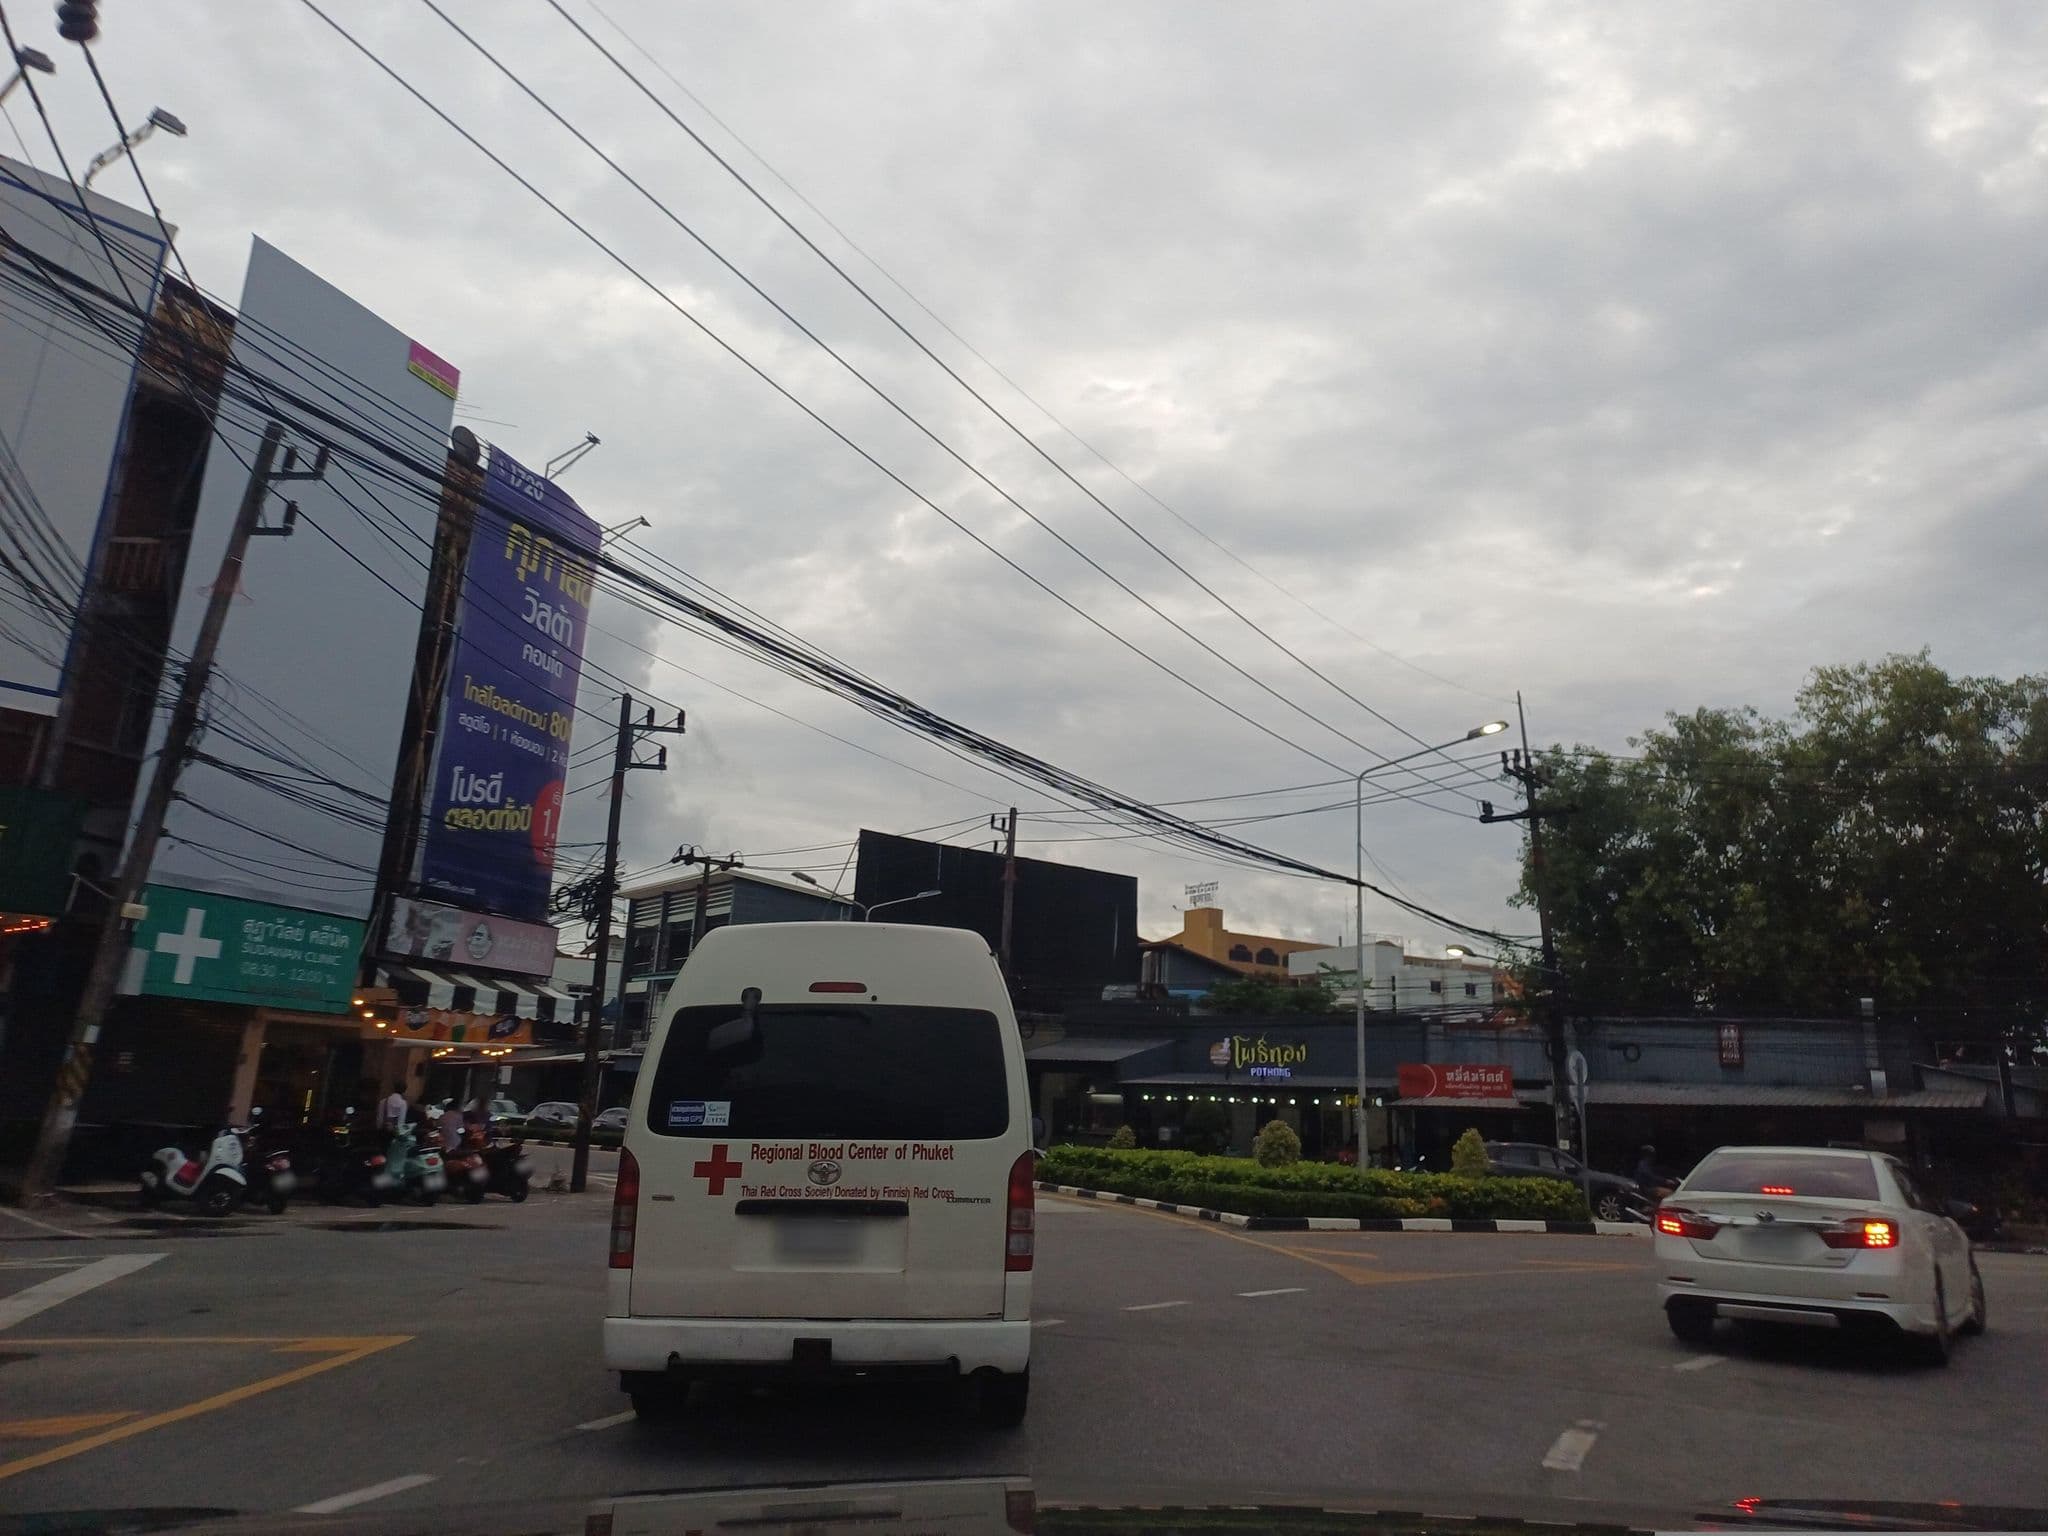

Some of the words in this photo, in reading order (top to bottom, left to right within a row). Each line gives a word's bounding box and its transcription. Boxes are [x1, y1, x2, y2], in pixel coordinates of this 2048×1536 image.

[522, 643, 563, 679] คอนโด
[449, 765, 504, 804] โปรดี
[443, 796, 533, 832] ตลอดทั้งปี
[1250, 1067, 1291, 1078] POTHONG
[751, 1144, 804, 1164] Regional
[808, 1143, 844, 1160] Blood
[848, 1143, 889, 1160] Center
[895, 1144, 908, 1160] of
[912, 1144, 954, 1161] Phuket
[741, 1186, 758, 1198] Thai
[760, 1186, 776, 1198] Red
[779, 1186, 802, 1198] Cross
[805, 1186, 833, 1199] Society
[834, 1186, 868, 1198] Donated
[870, 1186, 880, 1200] by
[882, 1186, 910, 1199] Finnish
[913, 1187, 929, 1199] Red
[932, 1187, 954, 1200] Cross
